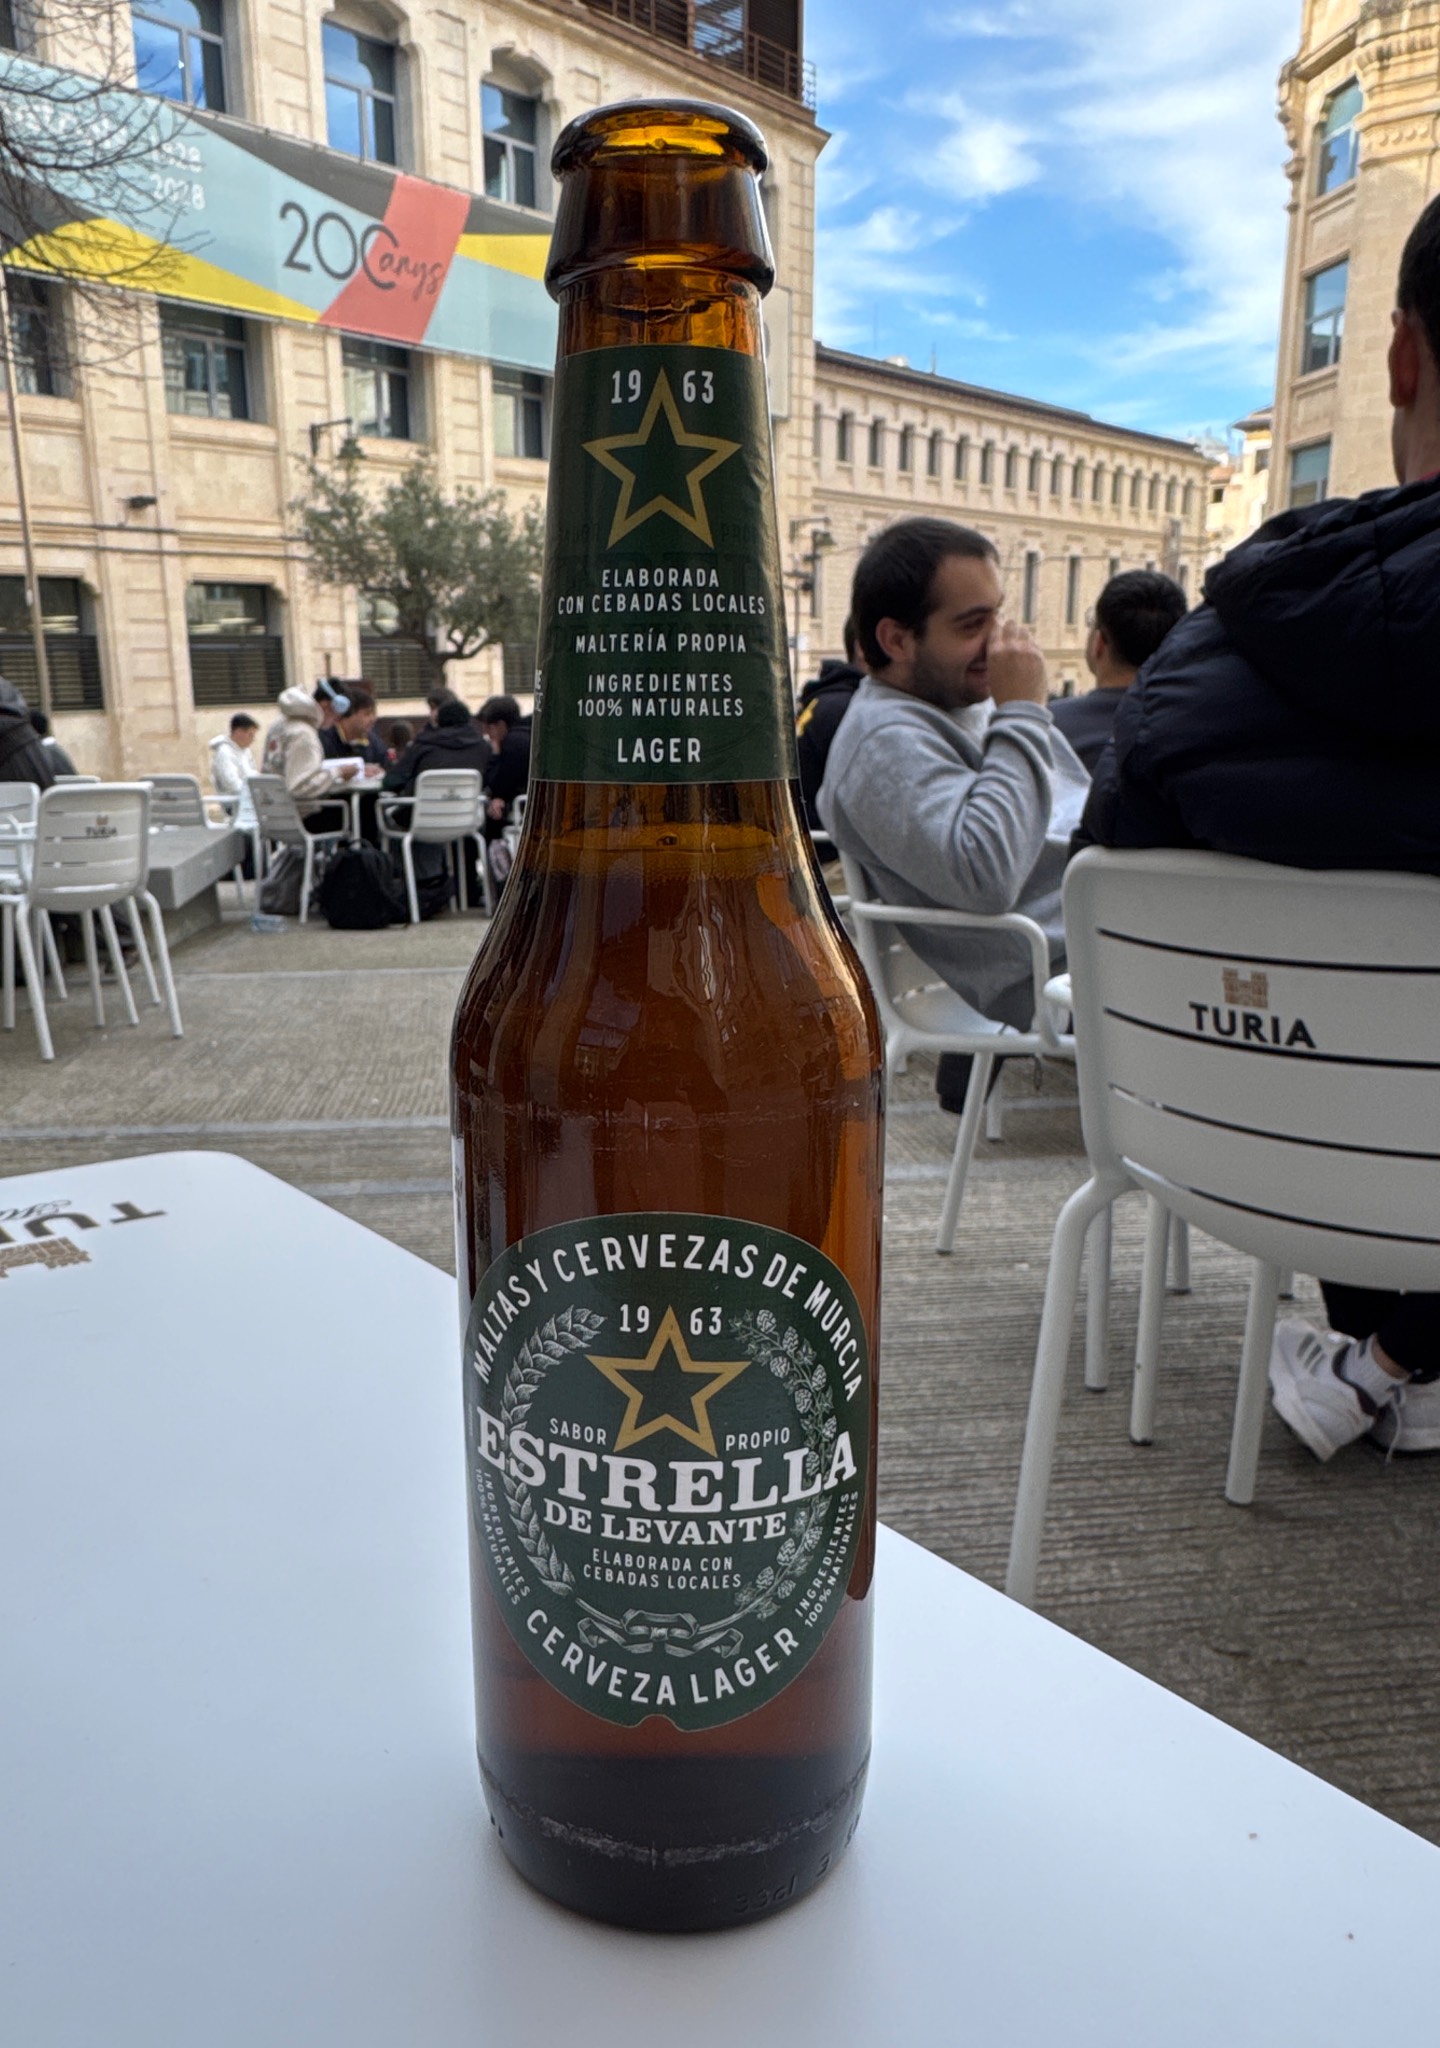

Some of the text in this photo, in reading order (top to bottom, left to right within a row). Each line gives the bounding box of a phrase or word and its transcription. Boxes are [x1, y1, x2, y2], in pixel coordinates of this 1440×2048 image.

[610, 369, 714, 404] 19 63
[602, 568, 719, 588] ELABORADA
[558, 593, 765, 615] CON CEBADAS LOCALES
[576, 628, 746, 653] MALTERÍA PROPIA
[588, 674, 733, 693] INGREDIENTES
[577, 698, 744, 717] 100% NATURALES
[617, 738, 701, 763] LAGER
[1188, 1001, 1317, 1049] TURIA
[473, 1233, 863, 1402] MALTAS Y CERVEZAS DE MURCIA
[619, 1303, 722, 1337] 19 63
[549, 1418, 791, 1452] SABOR PROPIO
[476, 1406, 857, 1513] ESTRELLA
[483, 1472, 530, 1597] INGREDIENTES
[544, 1497, 787, 1546] DE LEVANTE
[482, 1513, 521, 1605] NATURALES
[592, 1548, 733, 1572] ELABORADA CON
[795, 1493, 850, 1617] INGREDIENTES
[805, 1491, 858, 1628] 100% NATURALES
[583, 1564, 742, 1590] CEBADAS LOCALES
[525, 1608, 800, 1706] CERVEZA LAGER
